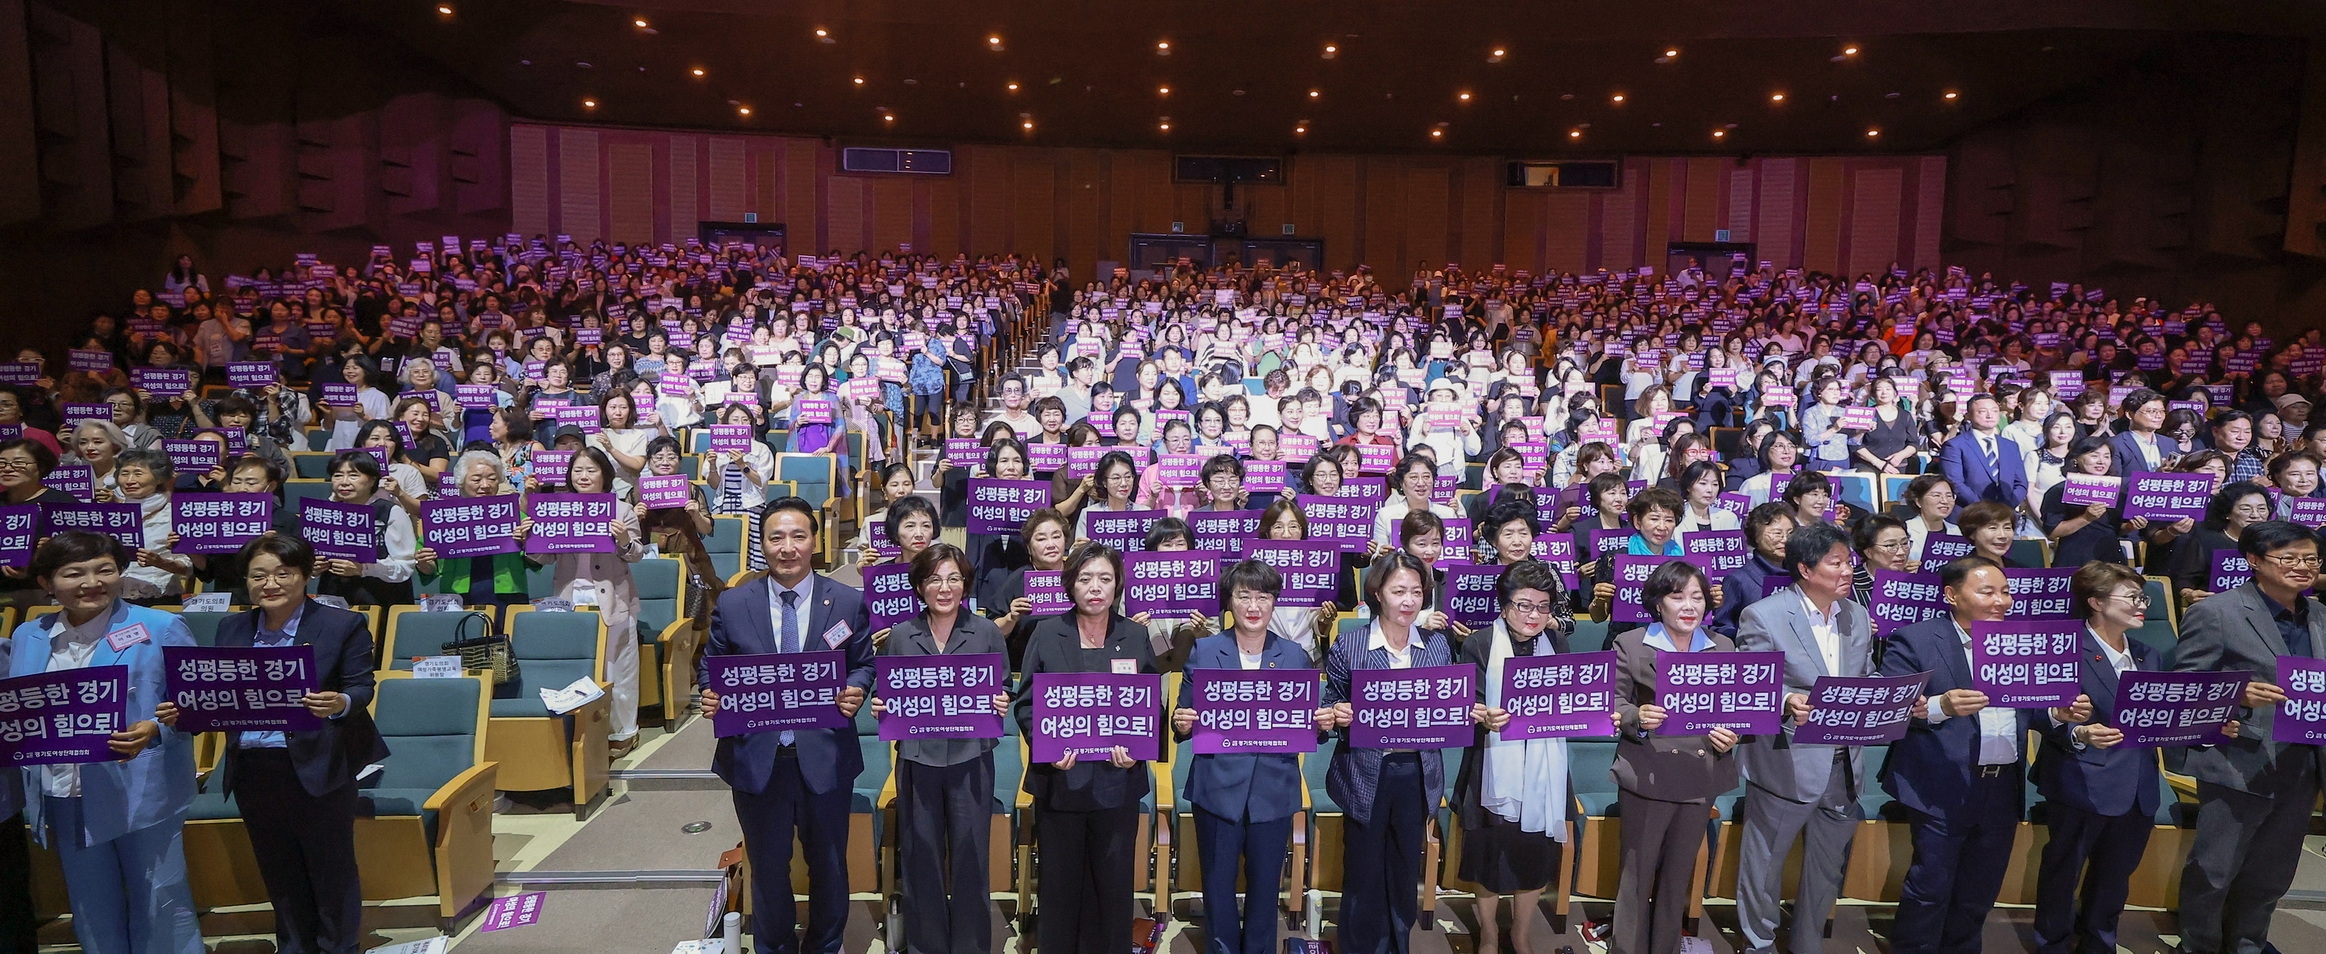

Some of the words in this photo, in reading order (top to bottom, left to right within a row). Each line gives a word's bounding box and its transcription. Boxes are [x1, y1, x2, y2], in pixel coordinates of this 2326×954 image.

[72, 469, 88, 479] 경기
[671, 478, 684, 488] 경기
[64, 481, 89, 492] 힘으로!
[1362, 483, 1382, 497] 경기
[2138, 478, 2184, 492] 성평등한
[2186, 480, 2208, 492] 경기
[974, 486, 1020, 503] 성평등한
[1024, 488, 1046, 504] 경기
[1537, 494, 1555, 506] 경기
[2131, 495, 2168, 508] 여성의
[2170, 496, 2204, 509] 힘으로!
[179, 502, 234, 517] 성평등한
[238, 500, 266, 516] 경기
[304, 506, 343, 523] 성평등한
[346, 511, 370, 528] 경기
[430, 506, 484, 522] 성평등한
[489, 502, 514, 518] 경기
[534, 502, 585, 518] 성평등한
[588, 502, 610, 516] 경기
[972, 506, 1006, 522] 여성의
[1304, 502, 1348, 519] 성평등한
[1350, 504, 1370, 520] 경기
[6, 514, 32, 530] 경기
[50, 510, 104, 527] 성평등한
[108, 511, 136, 528] 경기
[1093, 518, 1139, 534] 성평등한
[1195, 517, 1240, 533] 성평등한
[177, 522, 218, 538] 여성의
[221, 522, 266, 537] 힘으로!
[302, 528, 332, 544] 여성의
[333, 531, 372, 548] 힘으로!
[428, 527, 470, 544] 여성의
[532, 522, 571, 538] 여성의
[1335, 522, 1370, 538] 힘으로!
[1445, 526, 1467, 542] 경기
[0, 536, 30, 551] 으로!
[1550, 541, 1571, 556] 경기
[1689, 538, 1724, 553] 성평등한
[1726, 536, 1743, 550] 경기
[1250, 550, 1304, 567] 성평등한
[1308, 550, 1334, 567] 경기
[1718, 556, 1746, 572] 힘으로!
[1132, 560, 1184, 578] 성평등한
[1188, 559, 1214, 576] 경기
[1291, 572, 1334, 590] 힘으로!
[2009, 577, 2045, 594] 평등한
[2047, 576, 2072, 592] 경기
[1027, 593, 1052, 604] 여성의
[1130, 584, 1169, 602] 여성의
[1173, 582, 1216, 600] 힘으로!
[1882, 579, 1940, 602] 성평등한
[872, 599, 914, 617] 여성의
[1450, 597, 1490, 614] 여성의
[1876, 603, 1918, 622] 여성의
[2030, 598, 2070, 615] 힘으로!
[1983, 633, 2048, 656] 성평등한
[2051, 632, 2077, 654] 경기
[178, 658, 258, 681] 성평등한
[264, 658, 305, 680] 경기
[721, 663, 795, 686] 성평등한
[801, 660, 837, 680] 경기
[886, 666, 955, 688] 성평등한
[960, 666, 994, 686] 경기
[1512, 666, 1574, 689] 성평등한
[1579, 663, 1609, 684] 경기
[1668, 664, 1736, 686] 성평등한
[1742, 664, 1774, 684] 경기
[1980, 662, 2029, 684] 여성의
[2034, 662, 2078, 683] 힘으로!
[0, 683, 70, 711] 평등한
[78, 678, 118, 704] 경기
[1044, 685, 1112, 708] 성평등한
[1118, 685, 1150, 707] 경기
[1203, 681, 1272, 702] 성평등한
[1278, 681, 1310, 701] 경기
[1362, 680, 1430, 701] 성평등한
[1436, 676, 1468, 698] 경기
[1821, 685, 1889, 706] 성평등한
[1892, 682, 1922, 701] 경기
[2128, 682, 2203, 702] 성평등한
[2207, 681, 2240, 700] 경기
[178, 688, 239, 710] 여성의
[721, 690, 775, 712] 여성의
[886, 696, 936, 718] 여성의
[1507, 694, 1553, 716] 여성의
[1558, 692, 1609, 714] 힘으로!
[1663, 692, 1714, 714] 여성의
[1720, 692, 1776, 712] 힘으로!
[1200, 709, 1250, 730] 여성의
[1256, 709, 1312, 730] 힘으로!
[1358, 708, 1409, 728] 여성의
[1414, 704, 1470, 726] 힘으로!
[1808, 708, 1860, 728] 여성의
[1865, 706, 1912, 727] 힘으로!
[2119, 708, 2175, 728] 여성의
[2178, 706, 2232, 727] 힘으로!
[0, 716, 47, 741] 성의
[54, 711, 118, 737] 힘으로!
[1040, 715, 1092, 738] 여성의
[1097, 715, 1154, 737] 힘으로!
